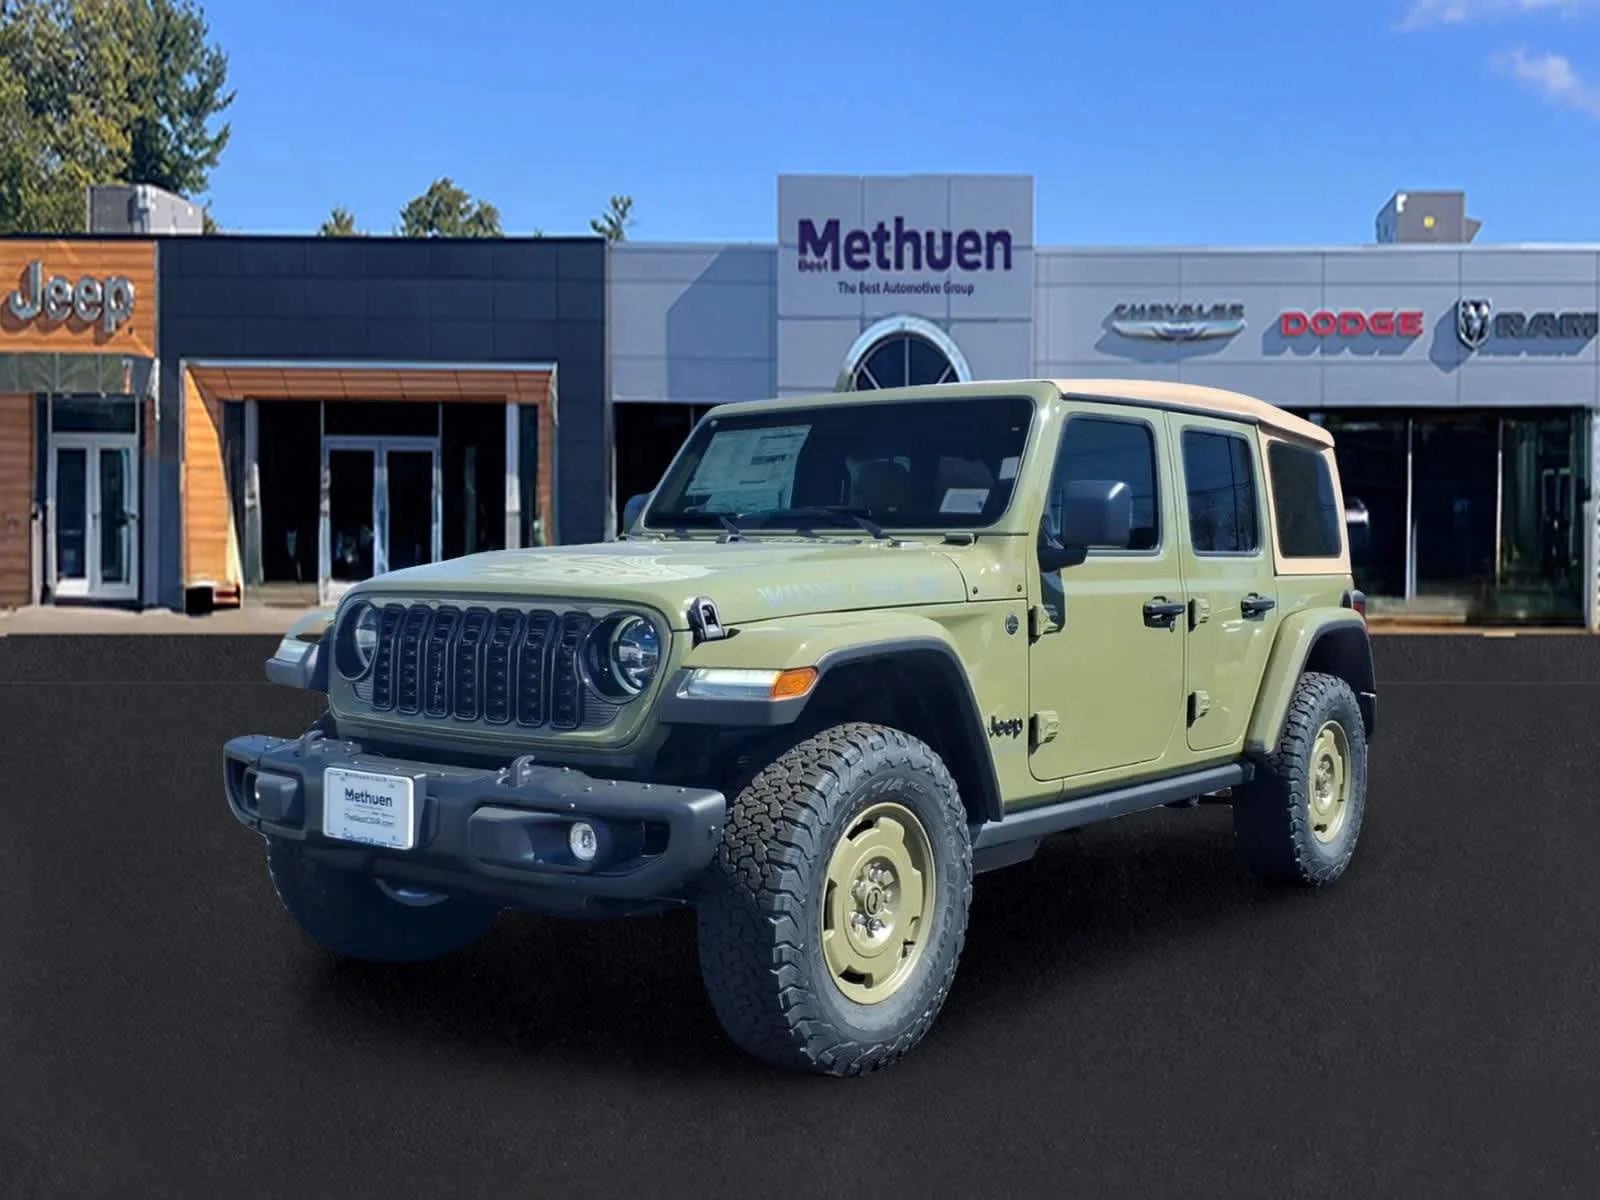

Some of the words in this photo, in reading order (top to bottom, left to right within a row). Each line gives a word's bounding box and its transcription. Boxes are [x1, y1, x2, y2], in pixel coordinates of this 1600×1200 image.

[797, 216, 1013, 272] Methuen
[8, 259, 135, 333] Jeep
[837, 281, 857, 295] The
[859, 281, 881, 295] Best
[883, 281, 941, 295] Automotive
[943, 281, 975, 297] Group
[1281, 311, 1423, 337] DODGE
[1495, 312, 1599, 338] RAM
[344, 787, 393, 807] Methuen
